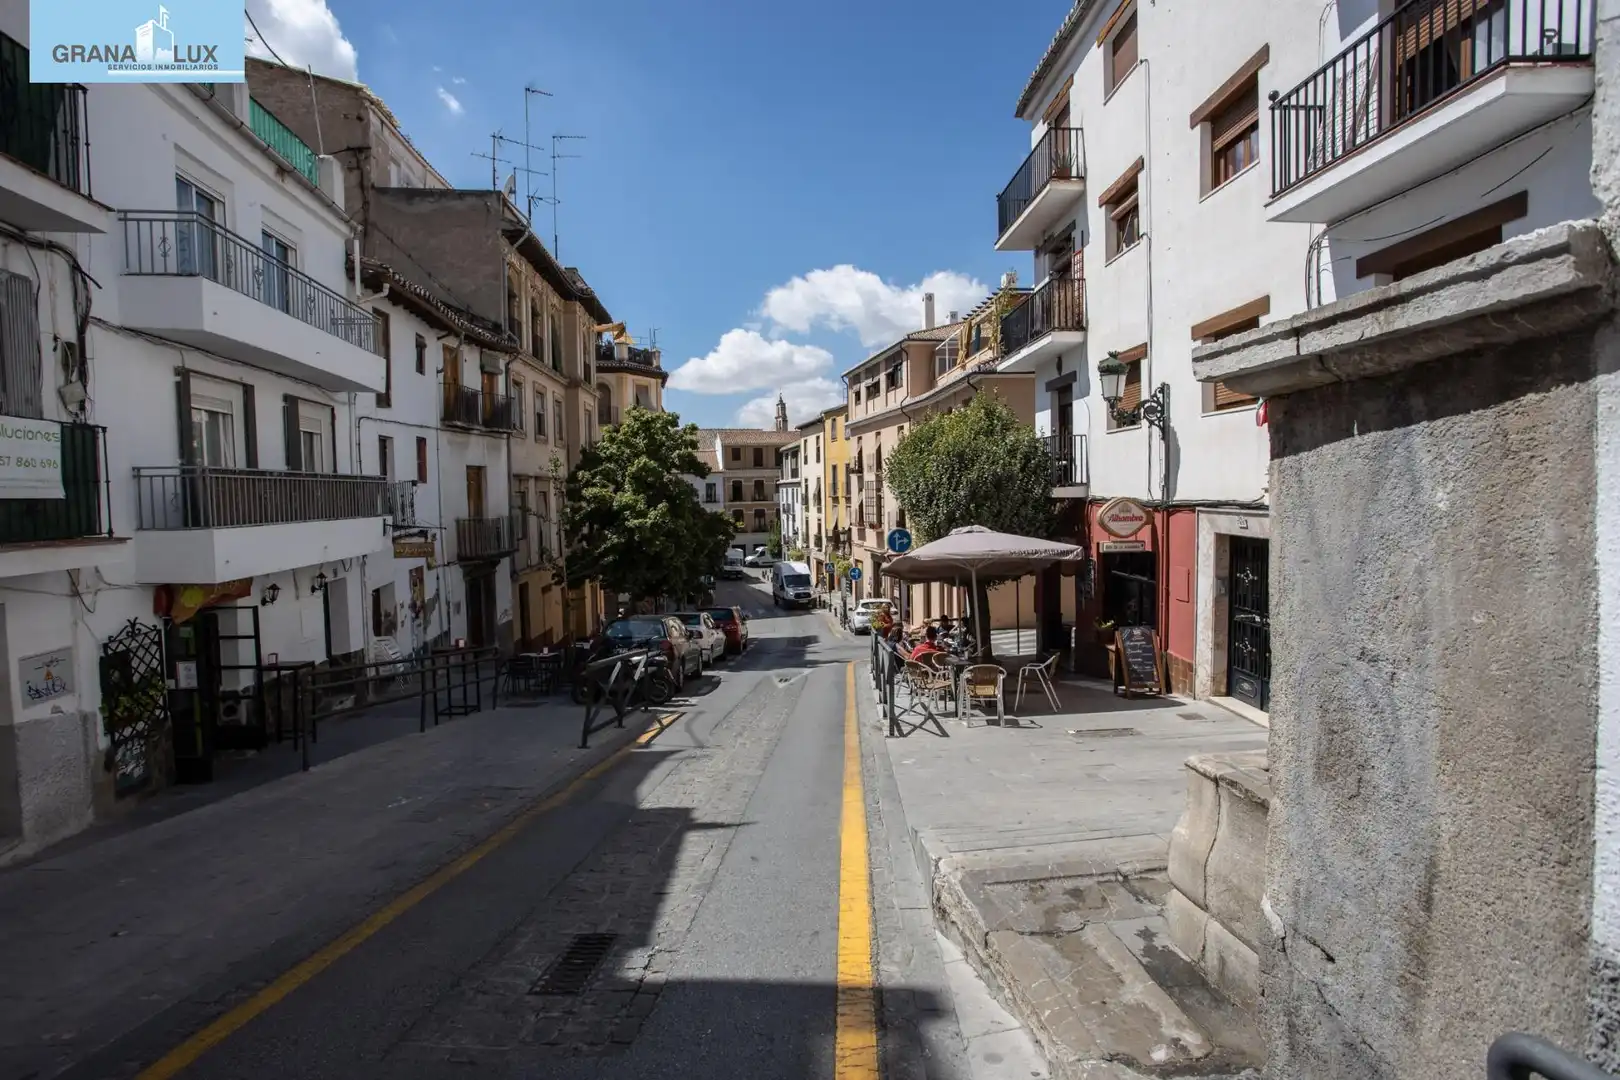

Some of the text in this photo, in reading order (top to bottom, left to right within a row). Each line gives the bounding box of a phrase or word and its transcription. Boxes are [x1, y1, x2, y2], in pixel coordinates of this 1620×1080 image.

[0, 424, 60, 442] luciones
[16, 457, 37, 468] 860
[1107, 513, 1144, 522] Alhambra
